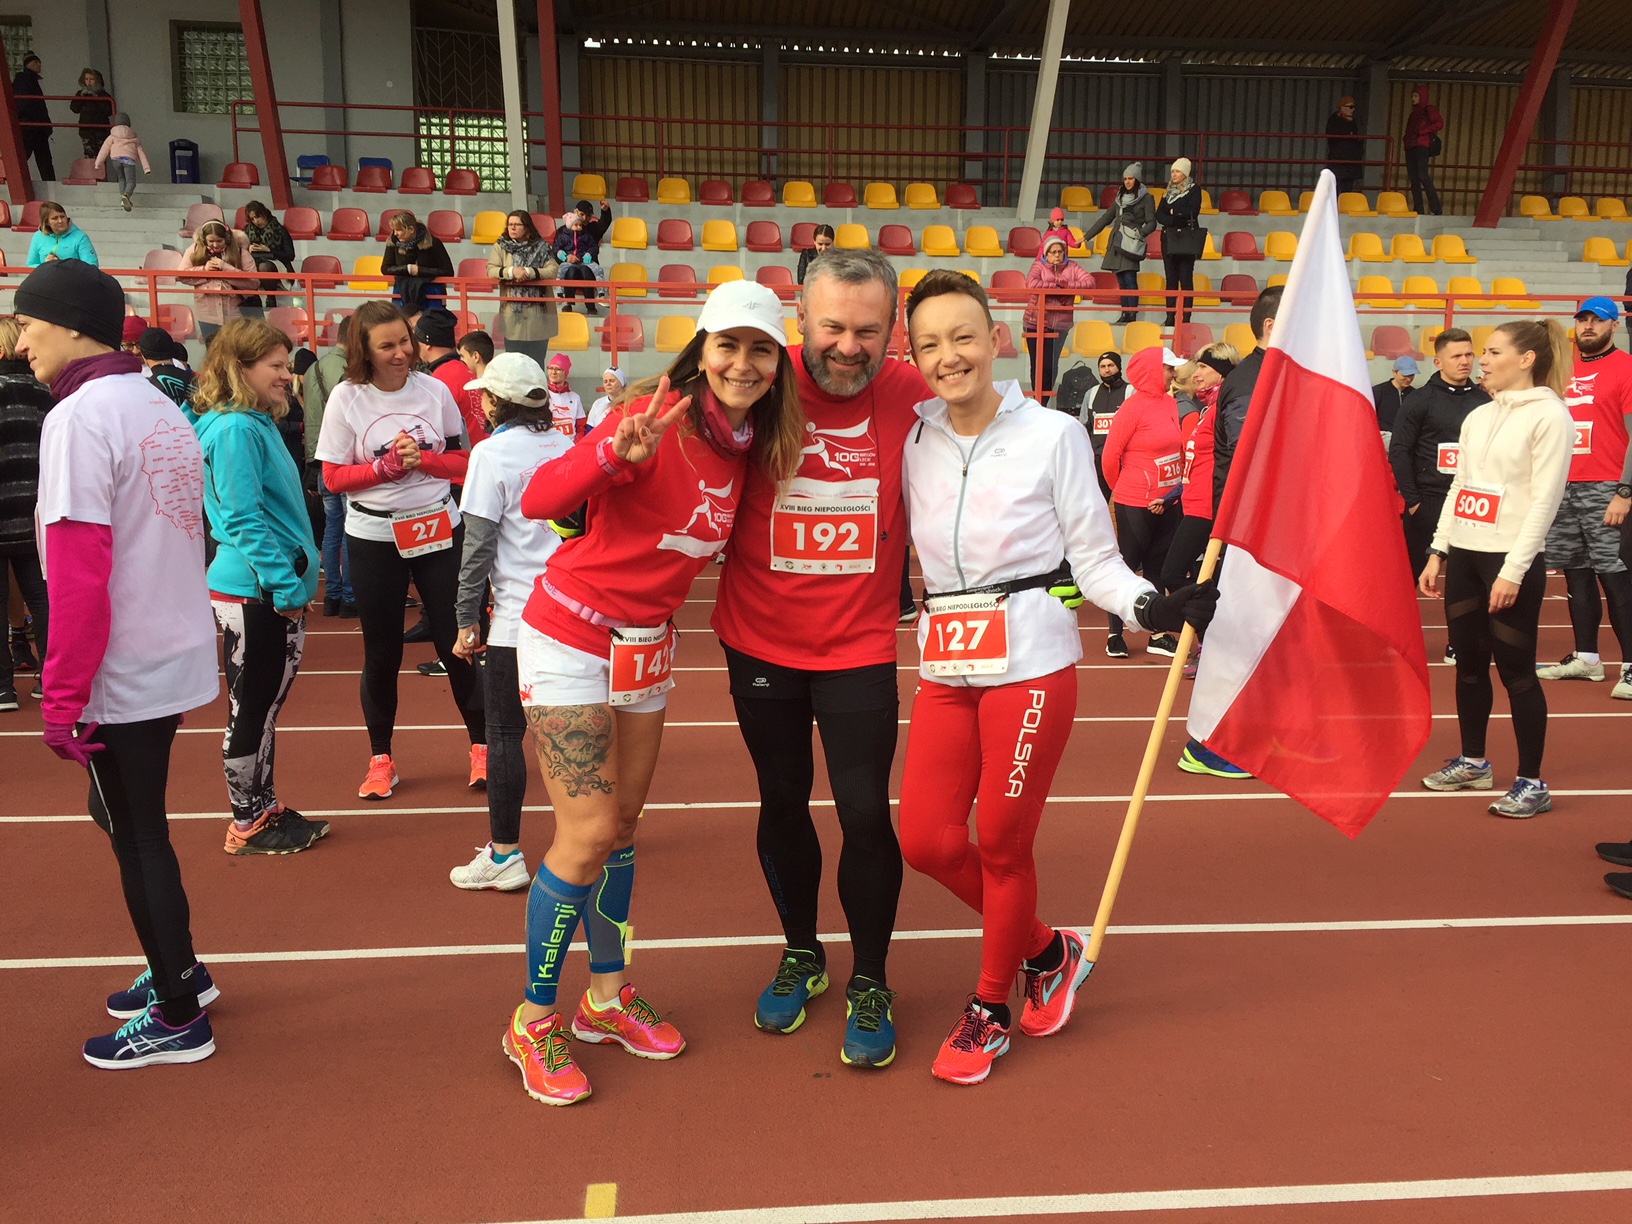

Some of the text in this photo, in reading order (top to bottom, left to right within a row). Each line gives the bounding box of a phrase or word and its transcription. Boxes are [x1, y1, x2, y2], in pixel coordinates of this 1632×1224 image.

[1445, 451, 1459, 466] 3
[797, 505, 813, 513] BIEG
[814, 504, 871, 513] NIEPODLEGŁOŚCI
[1457, 494, 1490, 517] 500
[411, 517, 440, 542] 27
[793, 521, 860, 552] 192
[935, 619, 990, 653] 127
[1004, 689, 1046, 798] POLSKA
